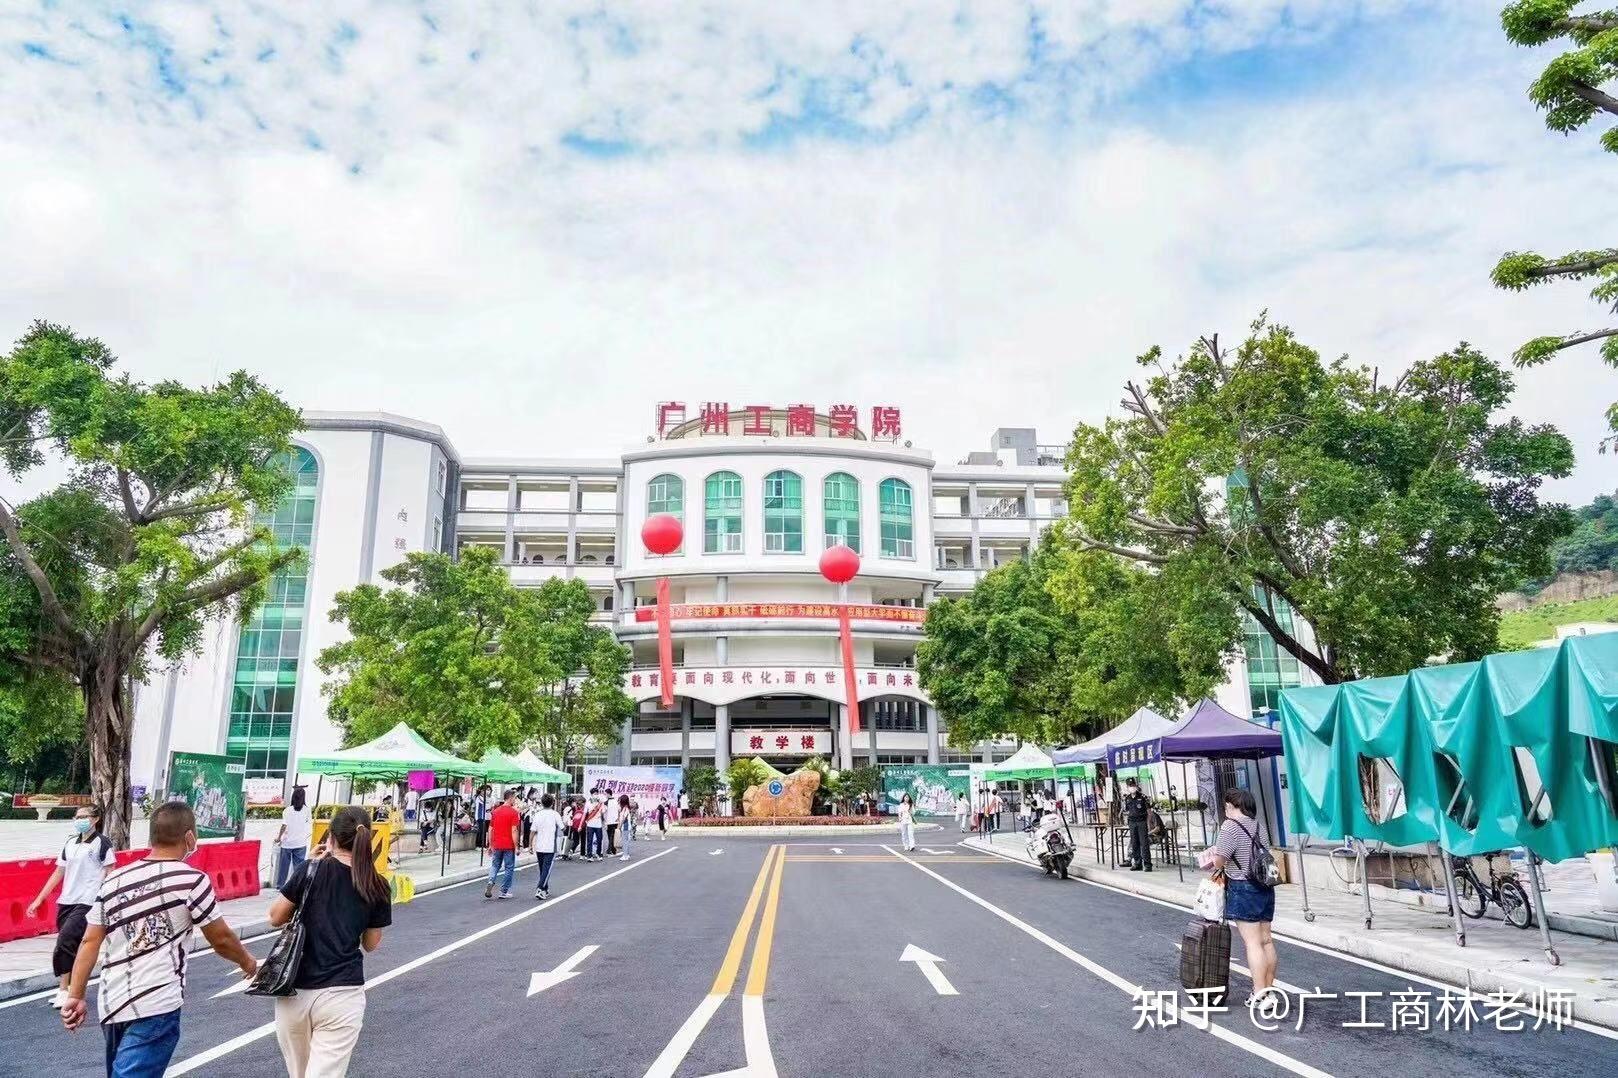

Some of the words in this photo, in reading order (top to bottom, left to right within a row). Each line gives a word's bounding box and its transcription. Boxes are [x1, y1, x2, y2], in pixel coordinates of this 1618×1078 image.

[658, 402, 902, 437] 广州工商学院
[749, 735, 815, 750] 教学楼
